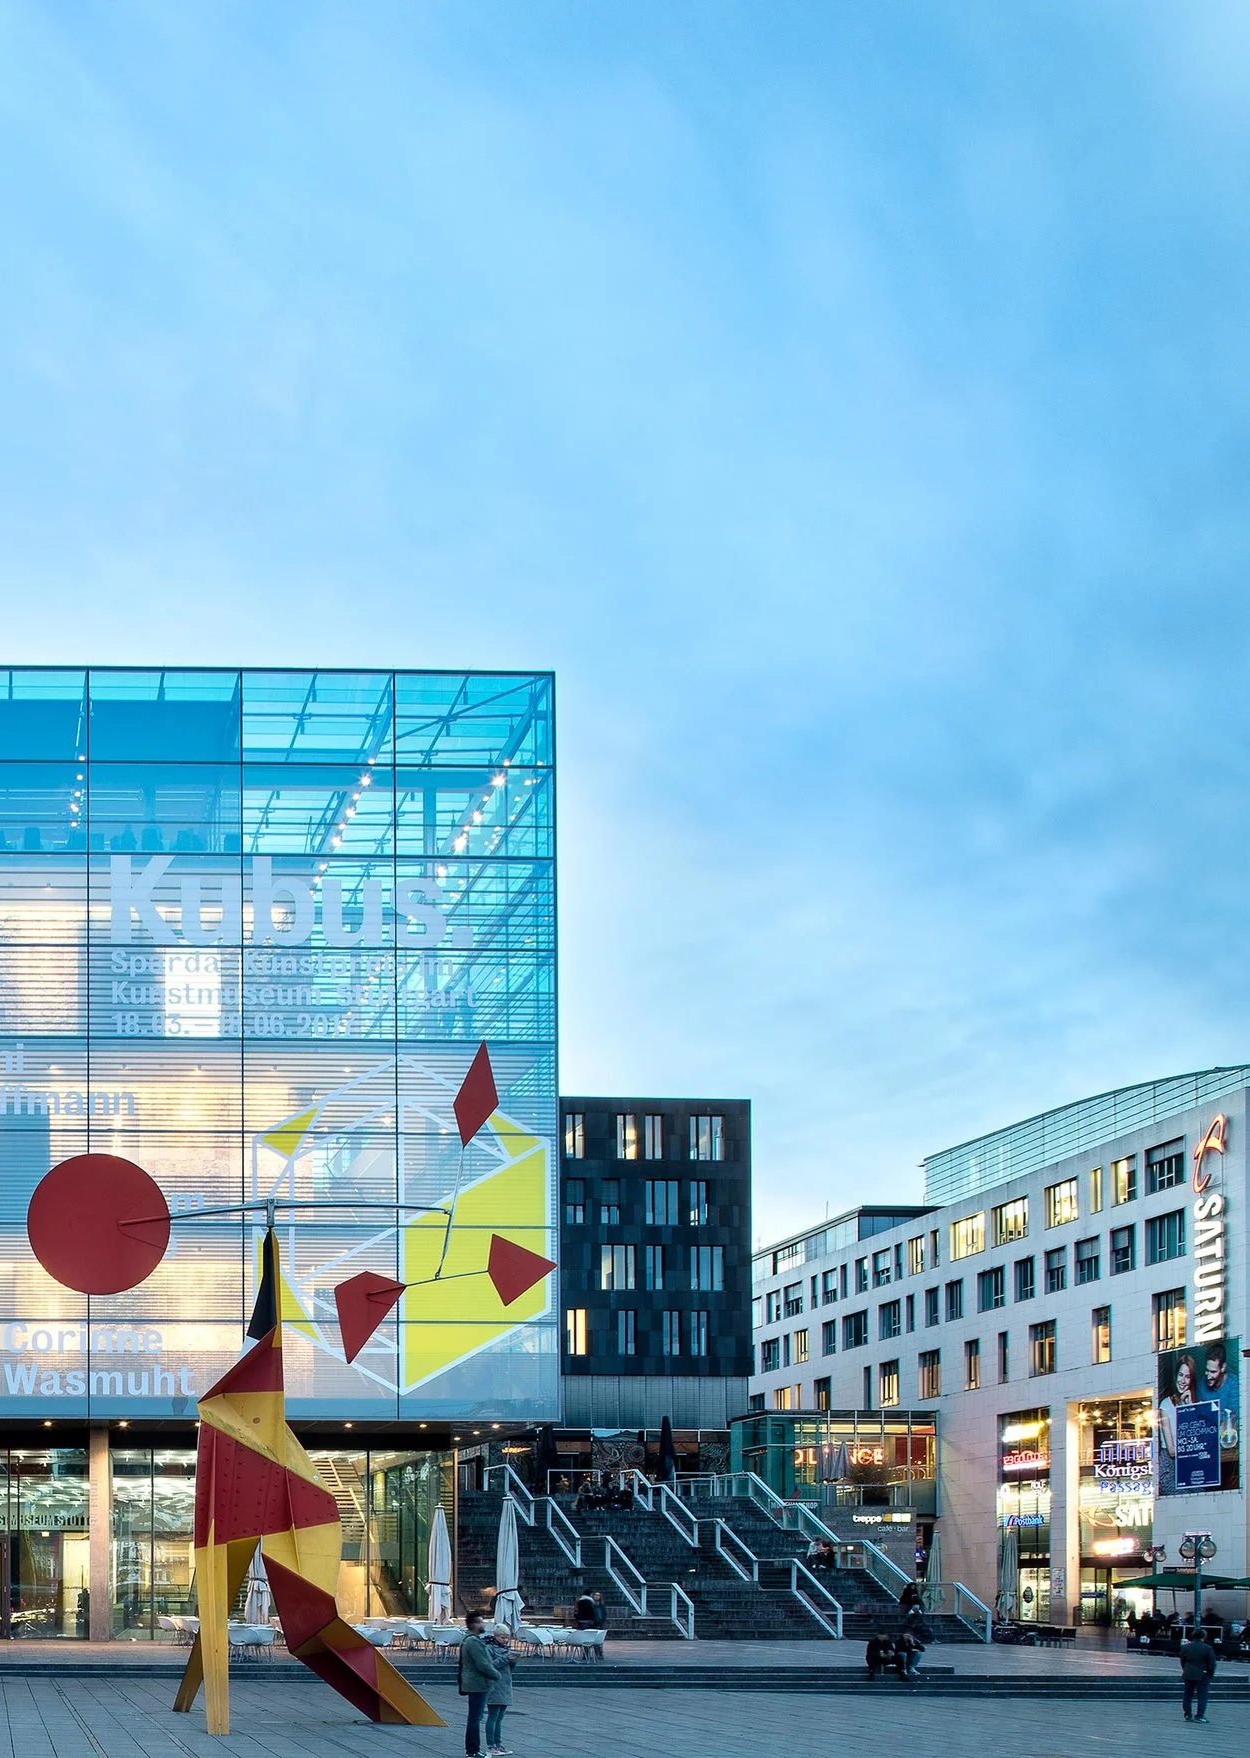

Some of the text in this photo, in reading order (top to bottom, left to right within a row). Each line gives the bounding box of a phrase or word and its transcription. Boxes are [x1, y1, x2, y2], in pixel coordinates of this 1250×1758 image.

[111, 981, 322, 1006] Kunstmuseum
[1193, 1193, 1224, 1344] SATURN
[3, 1321, 163, 1354] Corinne
[3, 1363, 196, 1396] Wasmuht
[1014, 1515, 1044, 1526] Postbank
